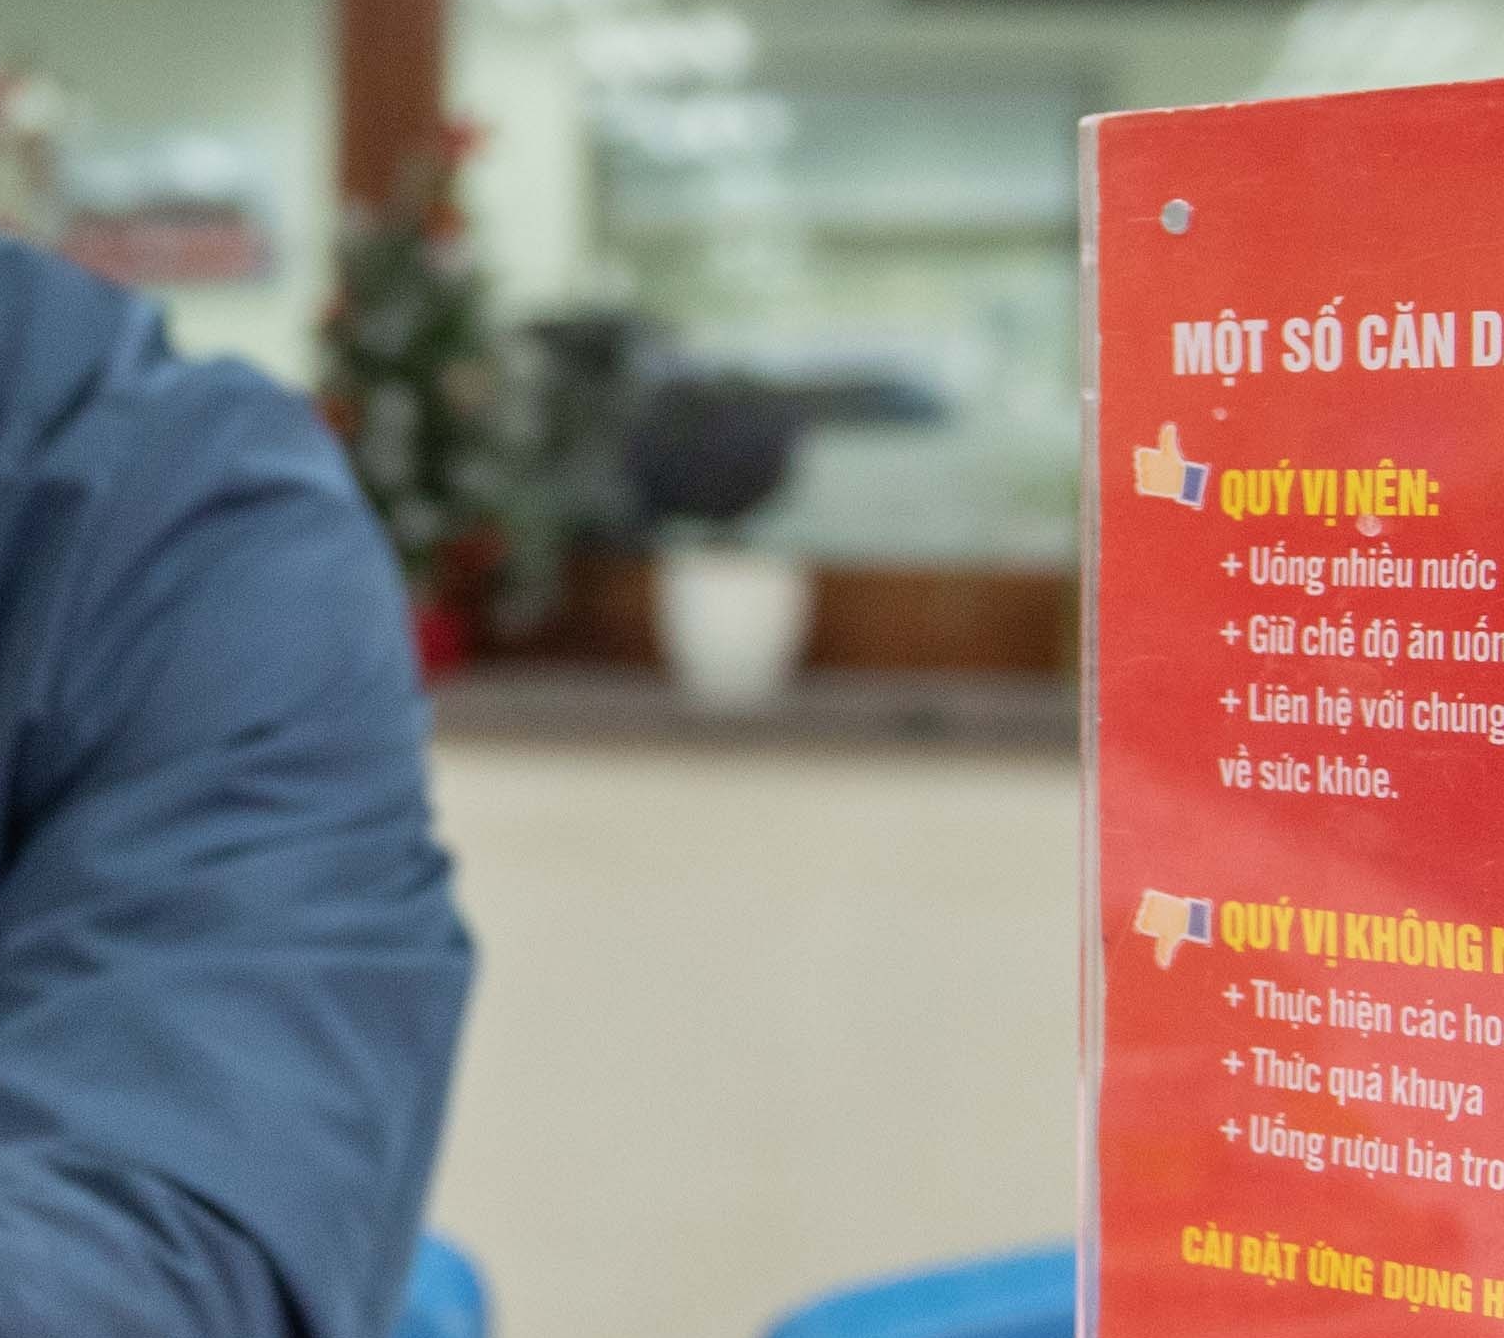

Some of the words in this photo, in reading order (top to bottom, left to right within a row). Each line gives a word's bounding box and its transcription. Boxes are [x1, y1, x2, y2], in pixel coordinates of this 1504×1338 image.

[1172, 309, 1268, 386] MỘT
[1282, 296, 1344, 372] SỐ
[1358, 301, 1455, 370] CĂN
[1220, 460, 1294, 520] QUÝ
[1302, 470, 1338, 527] VỊ
[1345, 458, 1440, 517] NÊN:
[1249, 541, 1325, 596] Uống
[1331, 542, 1413, 589] nhiều
[1421, 549, 1497, 590] nước
[1247, 614, 1295, 656] Giữ
[1302, 611, 1355, 657] chế
[1363, 617, 1400, 667] độ
[1408, 623, 1445, 661] ăn
[1248, 683, 1309, 726] Liên
[1316, 687, 1352, 735] hệ
[1360, 690, 1404, 730] với
[1218, 744, 1253, 790] về
[1259, 753, 1311, 795] sức
[1317, 753, 1400, 800] khỏe.
[1220, 897, 1294, 953] QUÝ
[1301, 909, 1339, 968] VỊ
[1346, 908, 1484, 974] KHÔNG
[1250, 979, 1322, 1030] Thực
[1329, 989, 1393, 1037] hiện
[1399, 997, 1457, 1043] các
[1250, 1046, 1322, 1095] Thức
[1390, 1064, 1485, 1122] khuya
[1249, 1112, 1326, 1173] Uống
[1331, 1132, 1399, 1180] rượu
[1406, 1137, 1453, 1185] bia
[1181, 1224, 1234, 1271] CÀI
[1239, 1235, 1301, 1289] ĐẶT
[1307, 1239, 1374, 1295] ỨNG
[1382, 1260, 1473, 1315] DỤNG
